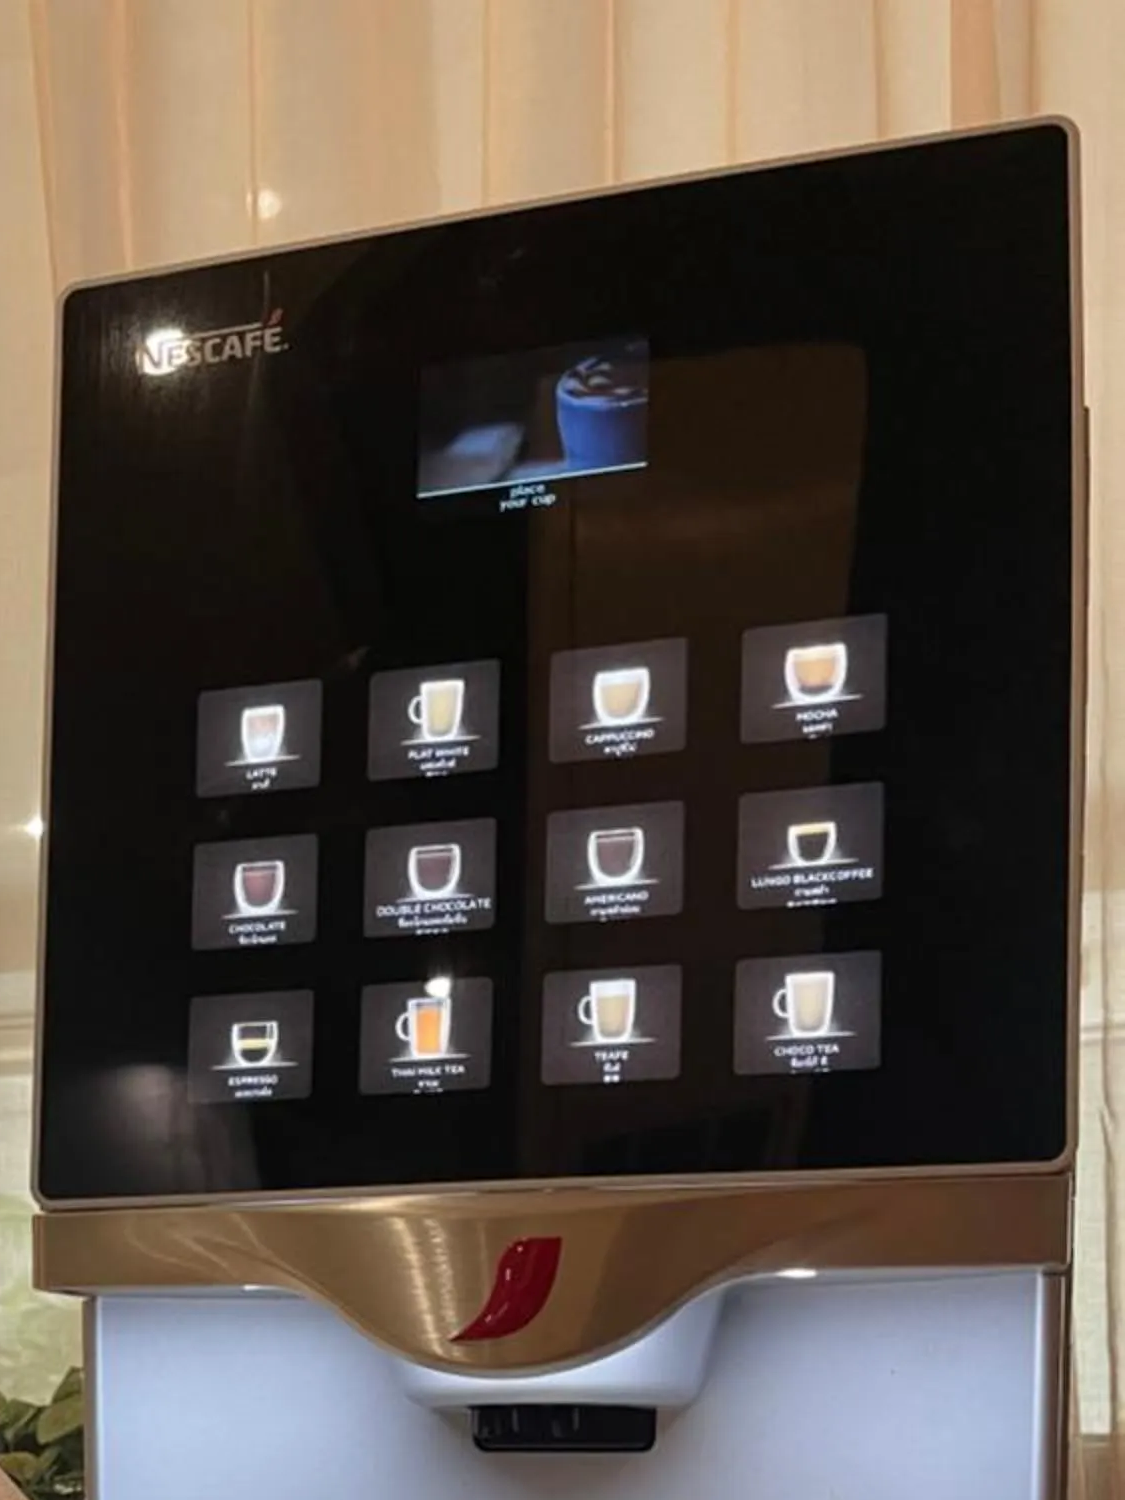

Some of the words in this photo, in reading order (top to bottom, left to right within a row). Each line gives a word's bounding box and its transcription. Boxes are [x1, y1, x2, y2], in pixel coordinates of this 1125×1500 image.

[509, 484, 546, 499] place
[499, 498, 528, 513] your
[531, 493, 557, 507] cup
[796, 708, 839, 721] MOCHA
[584, 729, 655, 745] CAPPUCCINO
[245, 766, 277, 781] LATTE
[584, 891, 650, 905] AMERICANO
[376, 904, 422, 917] DOUBLE
[424, 898, 491, 913] CHOCOLATE
[228, 919, 286, 935] CHOCOLATE
[774, 1045, 815, 1057] CHOCO
[817, 1043, 840, 1054] TEA
[444, 1063, 465, 1075] TEA
[227, 1073, 279, 1087] ESPRESSO
